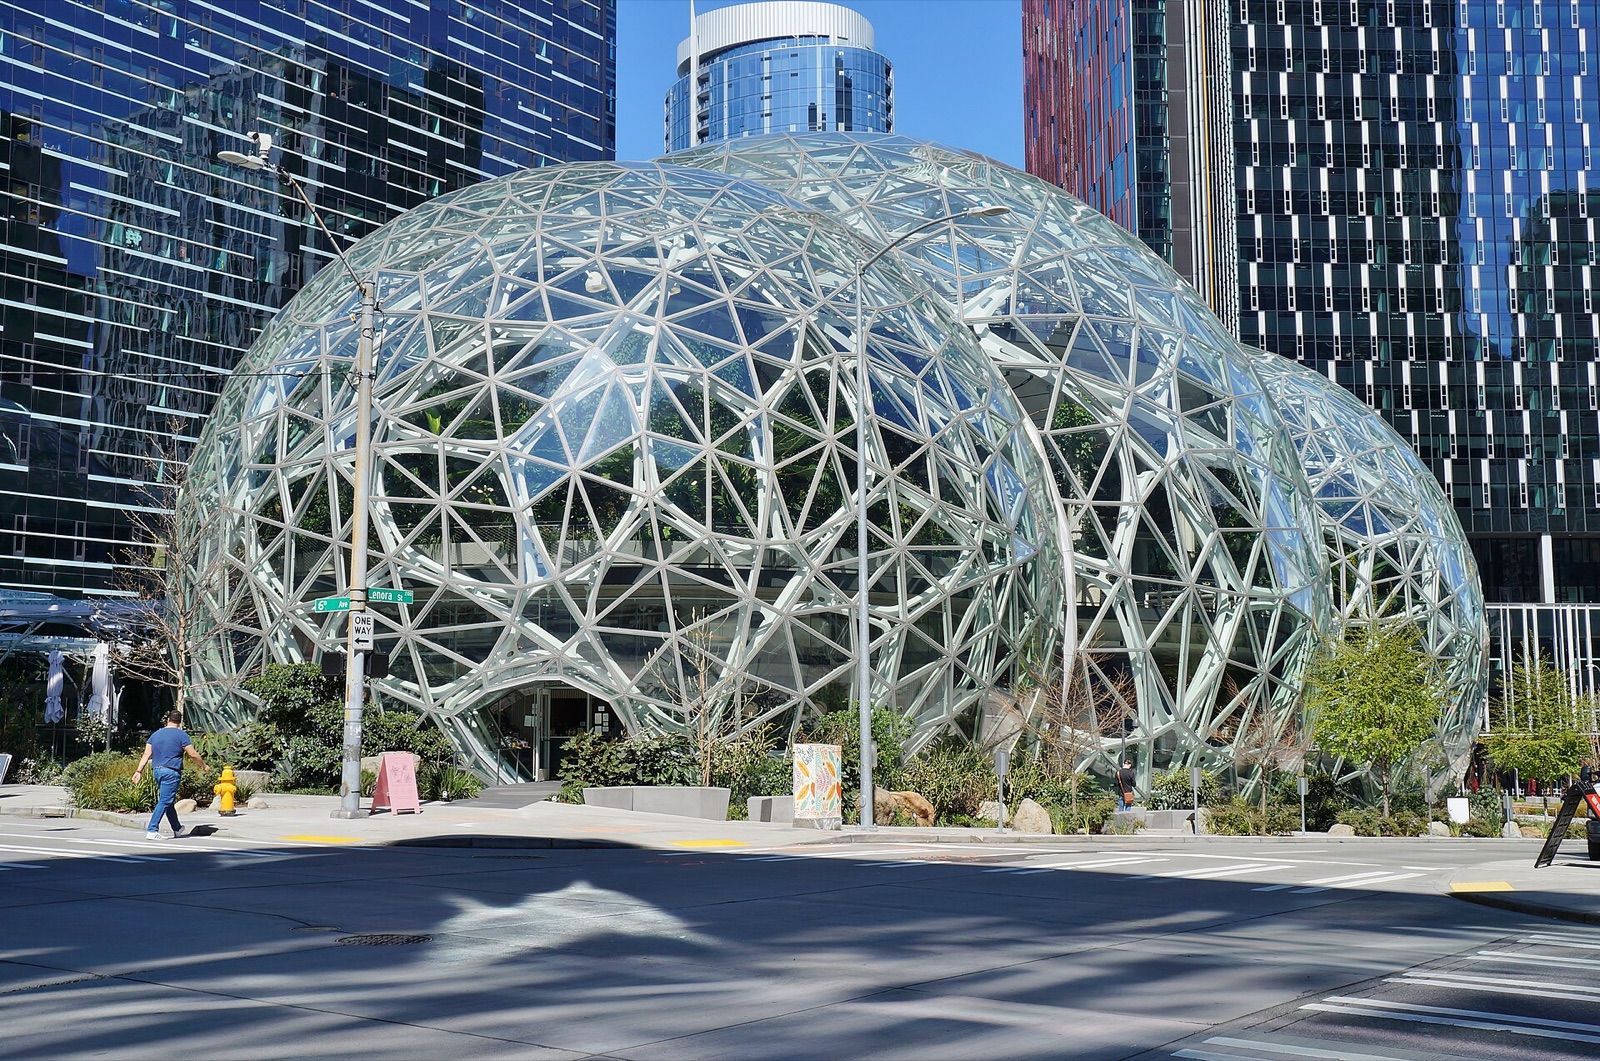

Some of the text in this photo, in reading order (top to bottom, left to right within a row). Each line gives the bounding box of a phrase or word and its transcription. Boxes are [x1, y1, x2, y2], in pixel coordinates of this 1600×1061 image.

[397, 594, 403, 602] St
[354, 616, 371, 625] ONE
[354, 626, 371, 635] WAY
